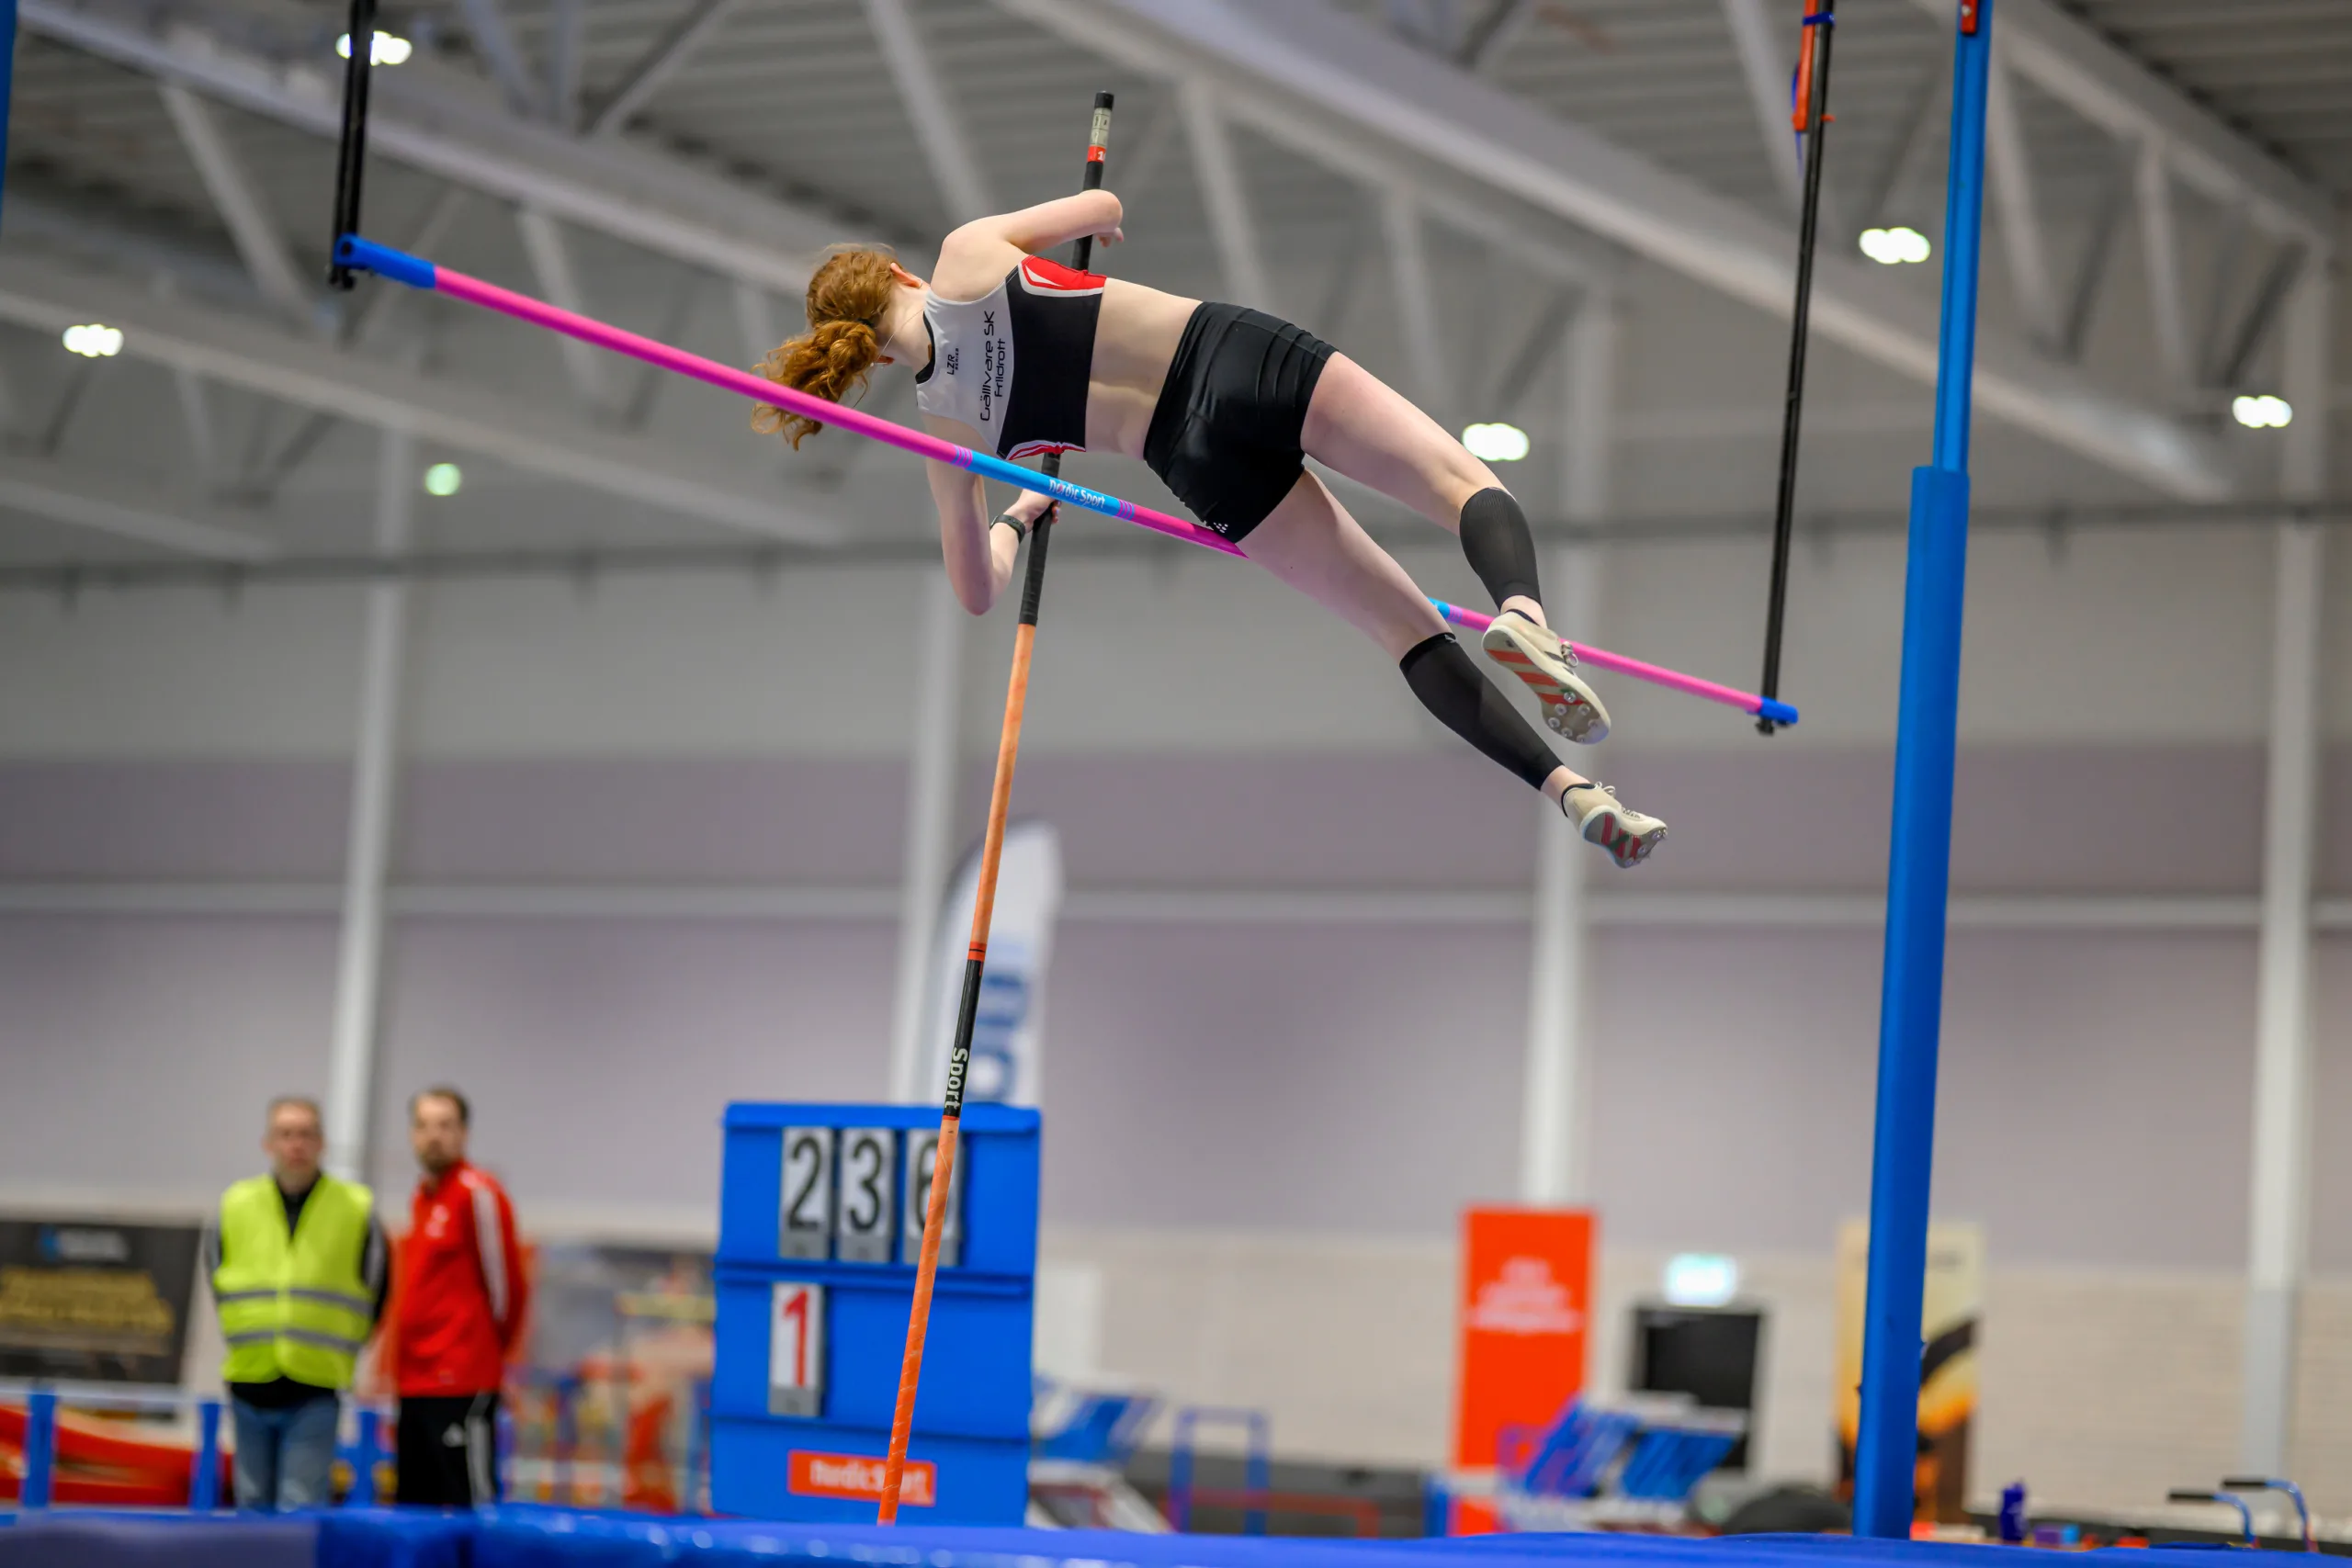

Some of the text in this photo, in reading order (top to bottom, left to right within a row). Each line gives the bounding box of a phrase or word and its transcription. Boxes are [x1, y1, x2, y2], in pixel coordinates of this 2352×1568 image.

[984, 310, 995, 336] SK
[946, 354, 956, 376] LZR
[1080, 489, 1106, 509] Sport
[944, 1047, 968, 1110] Sport
[783, 1288, 808, 1388] 1
